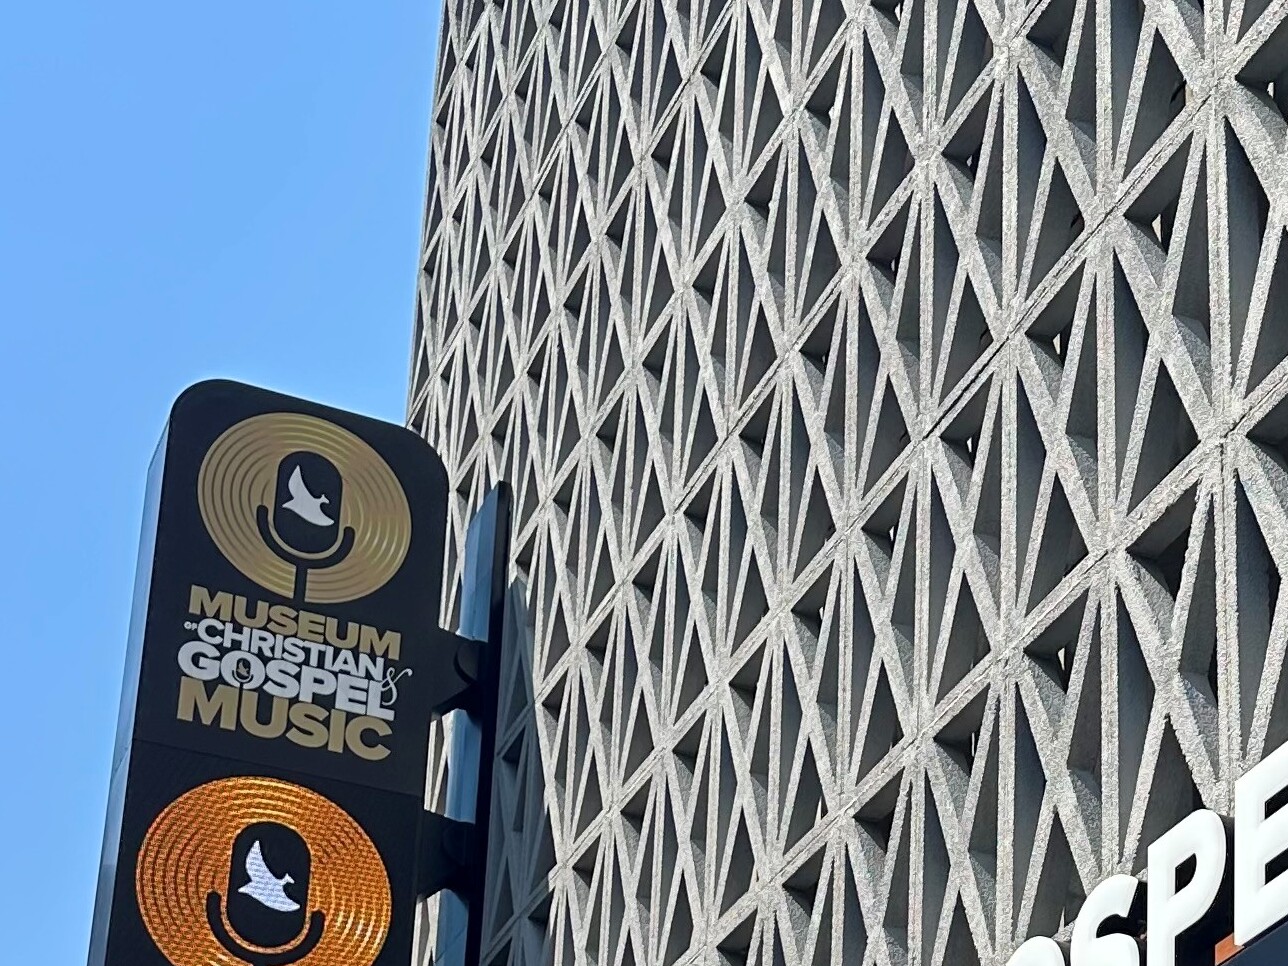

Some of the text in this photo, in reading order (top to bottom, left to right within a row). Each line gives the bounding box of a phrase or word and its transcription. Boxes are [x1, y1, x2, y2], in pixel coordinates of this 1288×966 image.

[188, 584, 401, 661] MUSEUM
[198, 618, 384, 681] CHRISTIAN
[381, 668, 412, 705] &
[177, 640, 395, 721] GOSPEL
[177, 675, 391, 761] MUSIC
